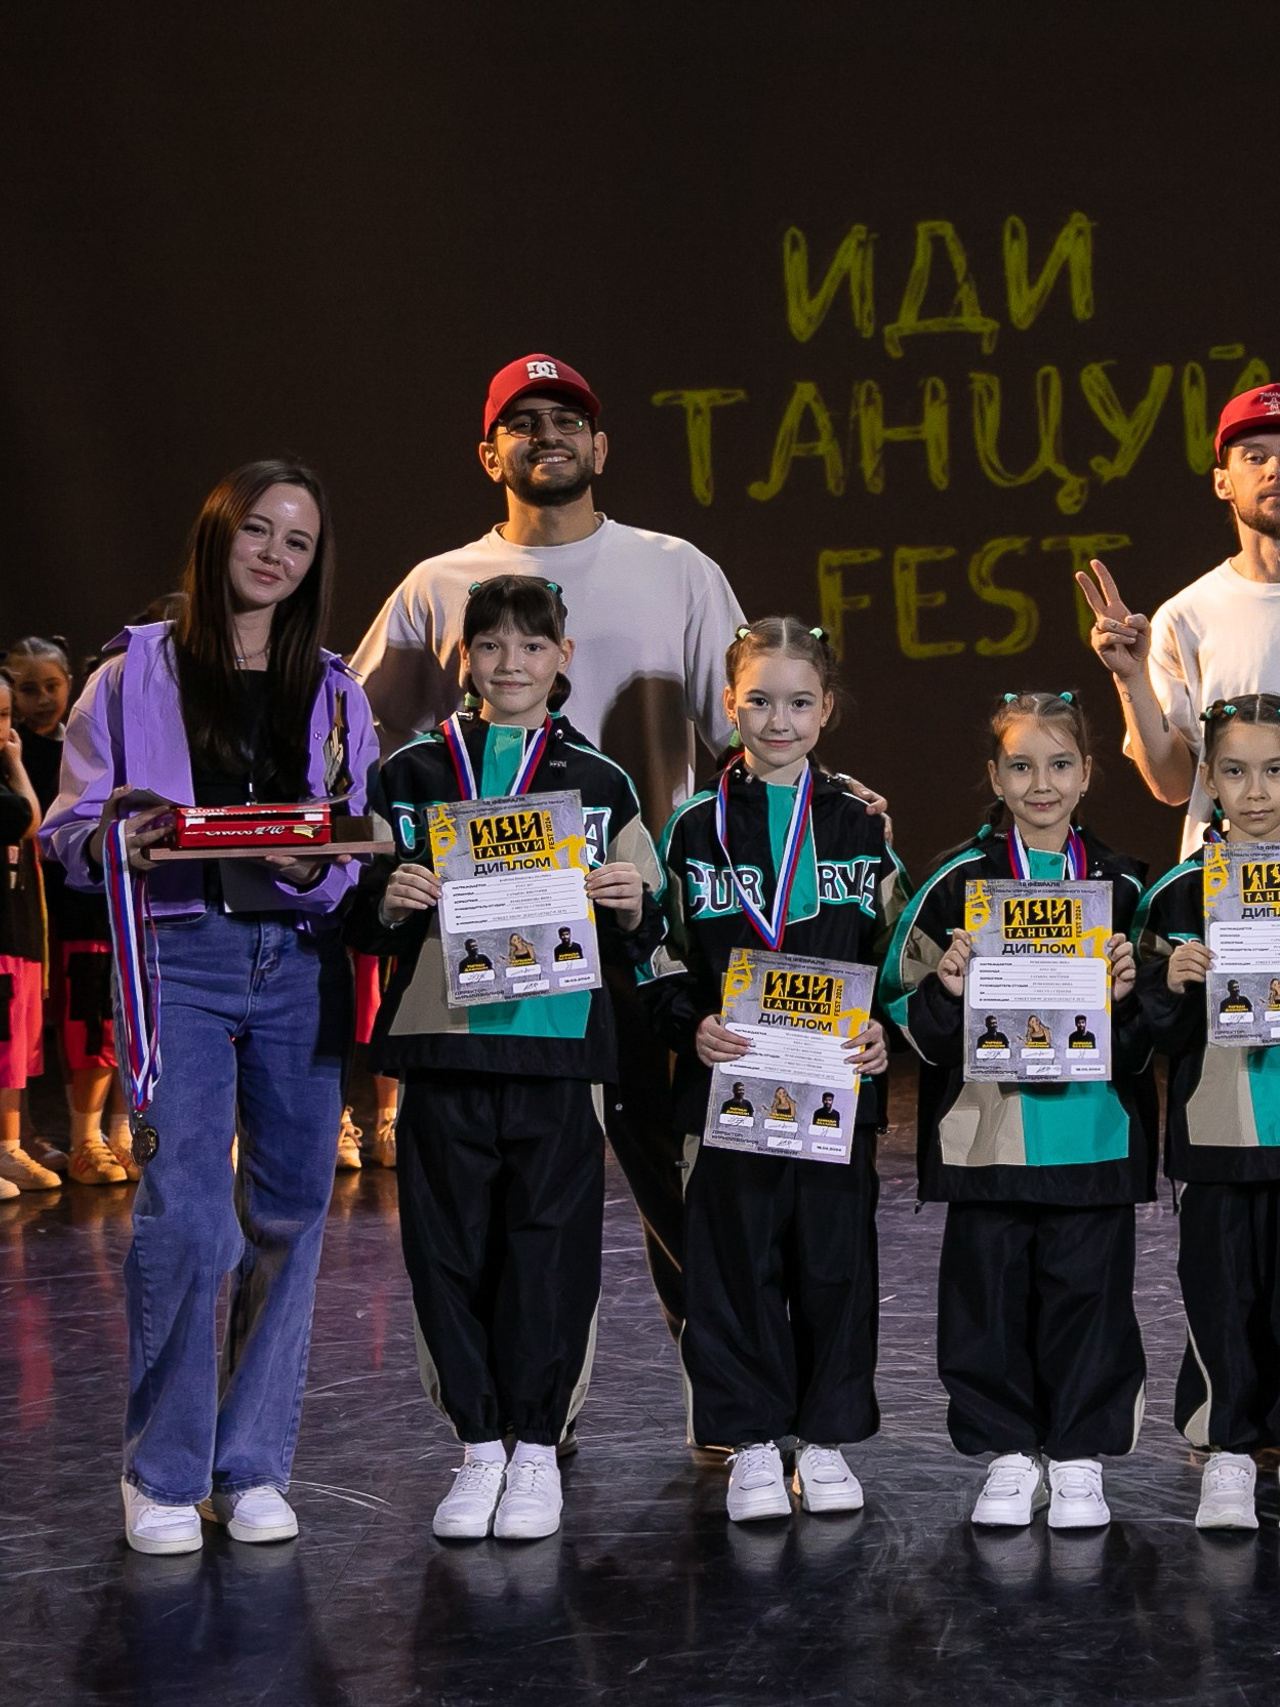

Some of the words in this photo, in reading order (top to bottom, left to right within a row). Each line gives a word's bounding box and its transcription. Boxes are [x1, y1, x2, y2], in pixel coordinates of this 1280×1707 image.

[783, 212, 1098, 358] ИДИ
[526, 361, 559, 379] DC
[652, 343, 1271, 515] ТАНЦУЙ
[818, 533, 1131, 662] FEST
[474, 857, 551, 876] ДИПЛОМ
[1002, 944, 1076, 956] ДИПЛОМ
[758, 1012, 832, 1033] ДИПЛОМ
